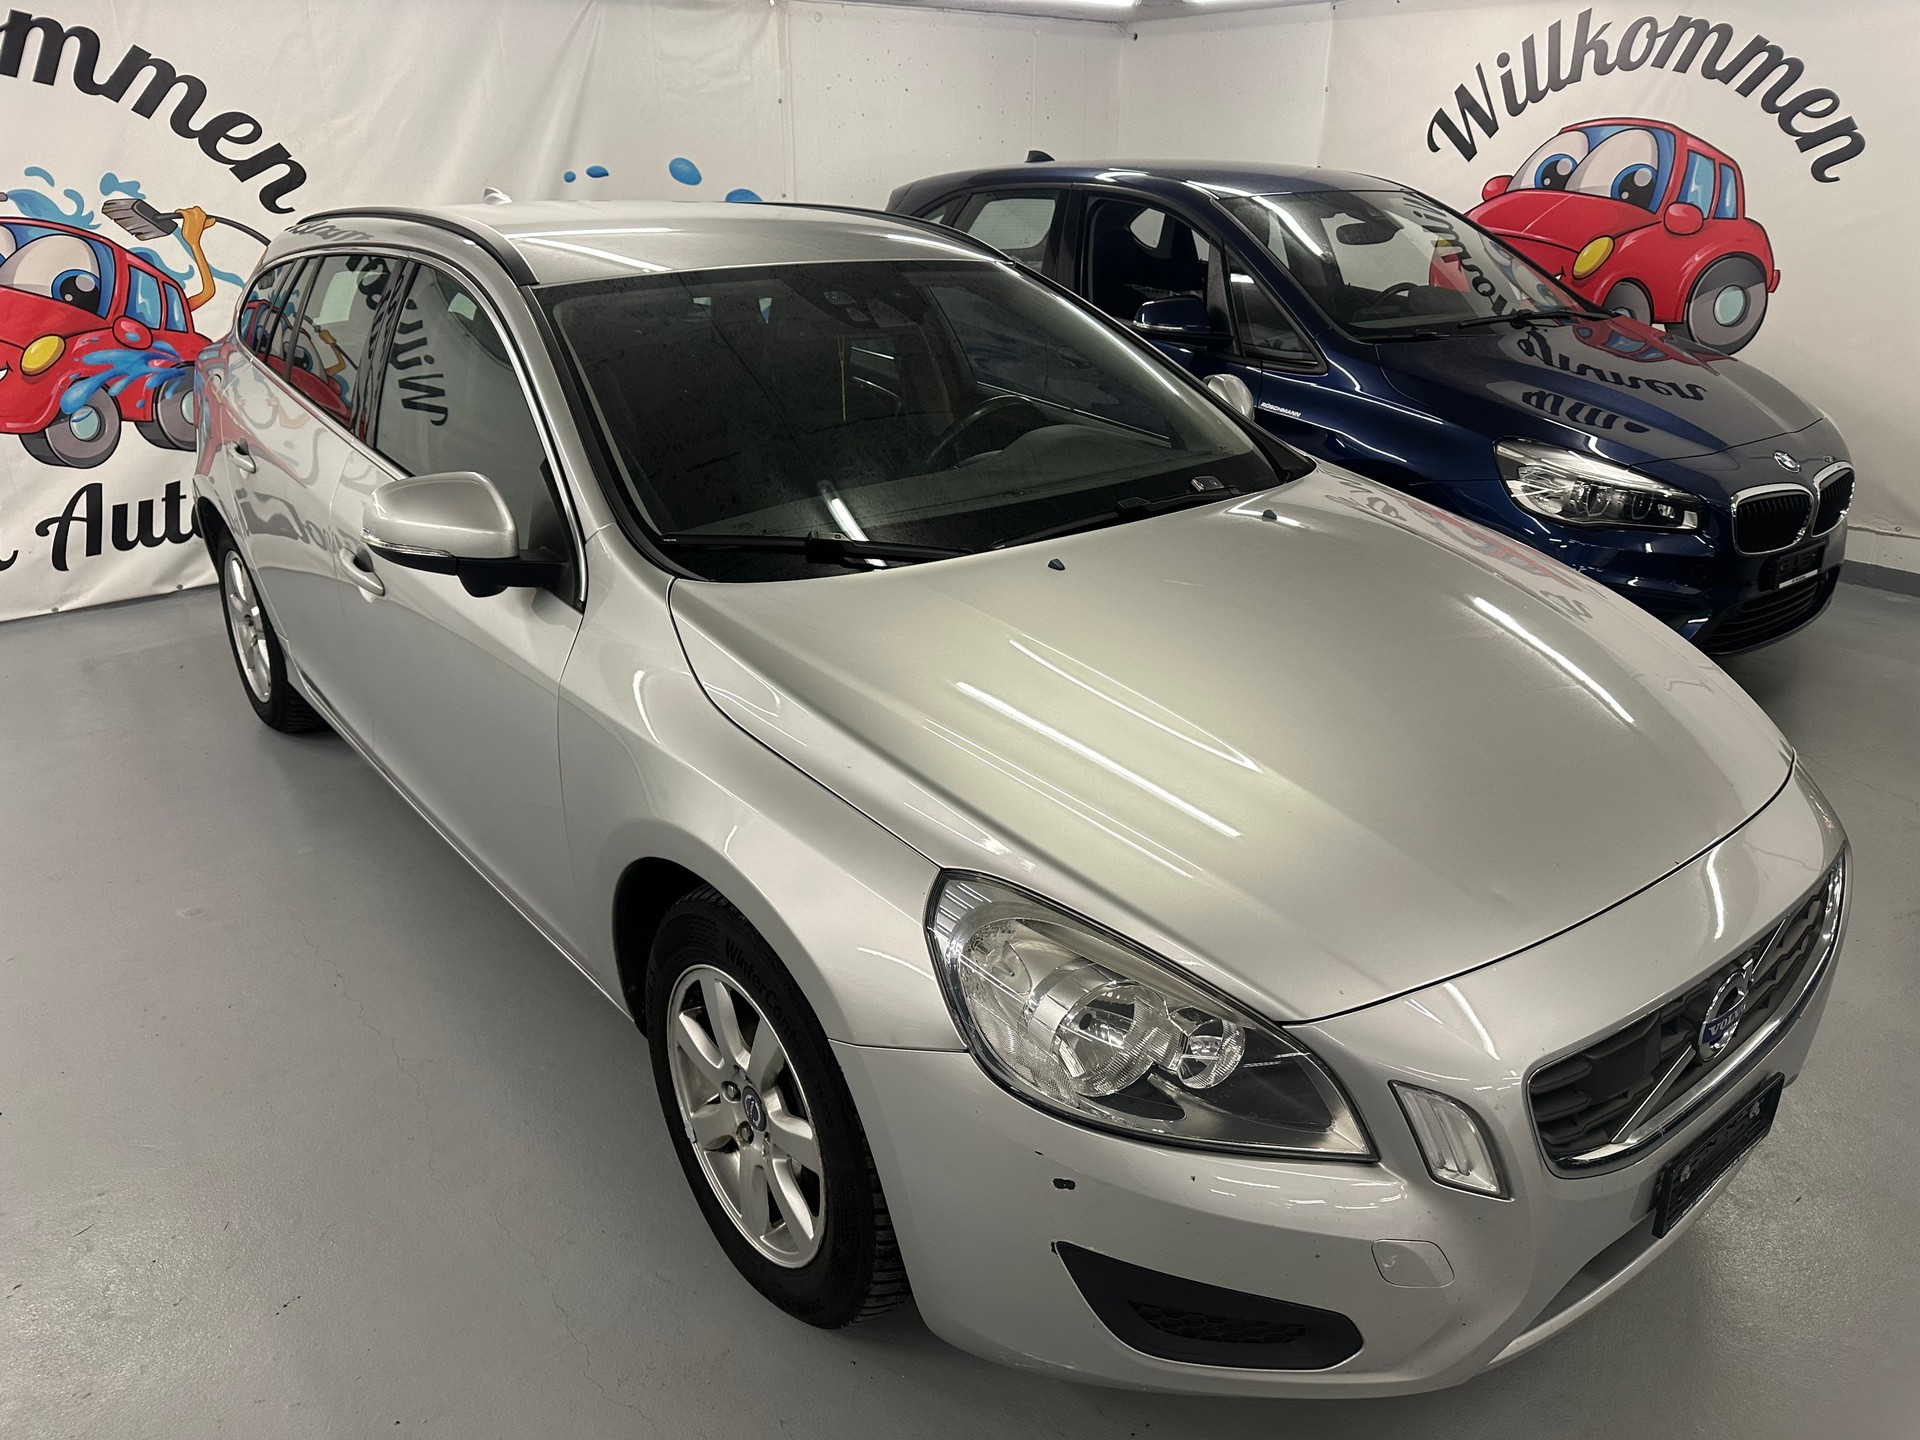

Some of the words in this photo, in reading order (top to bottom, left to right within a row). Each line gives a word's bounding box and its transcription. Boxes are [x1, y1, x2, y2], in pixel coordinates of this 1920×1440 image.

[0, 9, 307, 215] mmen
[1427, 7, 1866, 183] Willkommen
[1708, 1003, 1747, 1036] VOLVO
